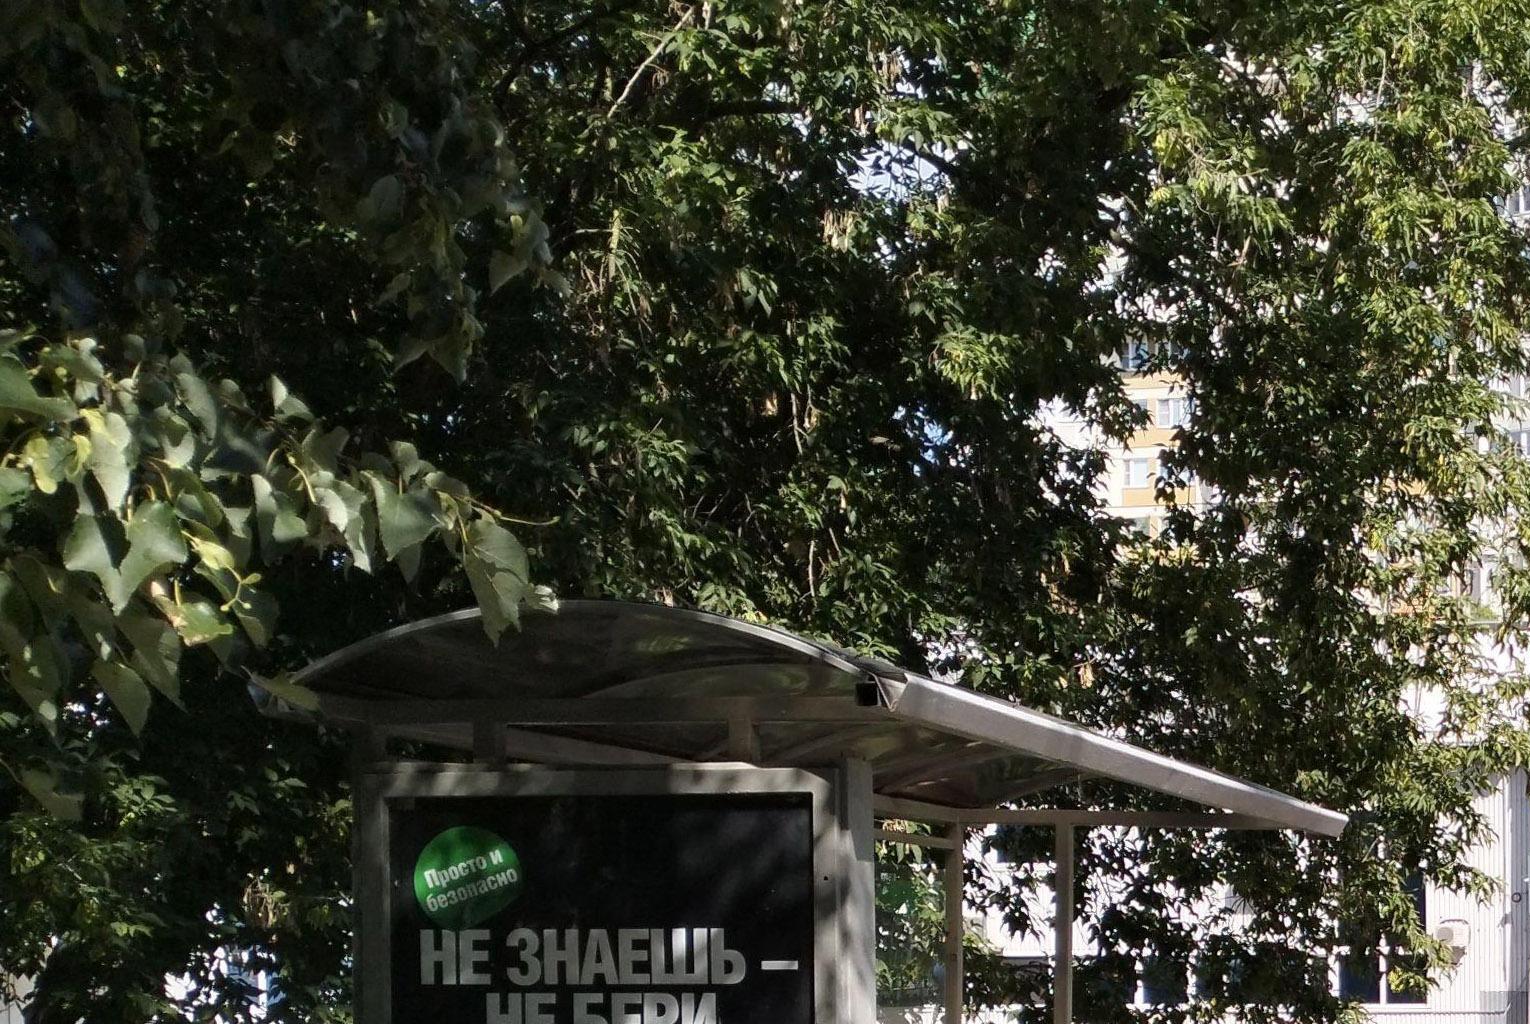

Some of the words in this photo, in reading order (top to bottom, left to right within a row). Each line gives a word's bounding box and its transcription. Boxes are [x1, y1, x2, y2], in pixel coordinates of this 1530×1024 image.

[424, 856, 488, 888] Просто
[426, 868, 518, 912] безопасно
[419, 928, 491, 986] НЕ
[506, 927, 746, 986] ЗНАЕШЬ
